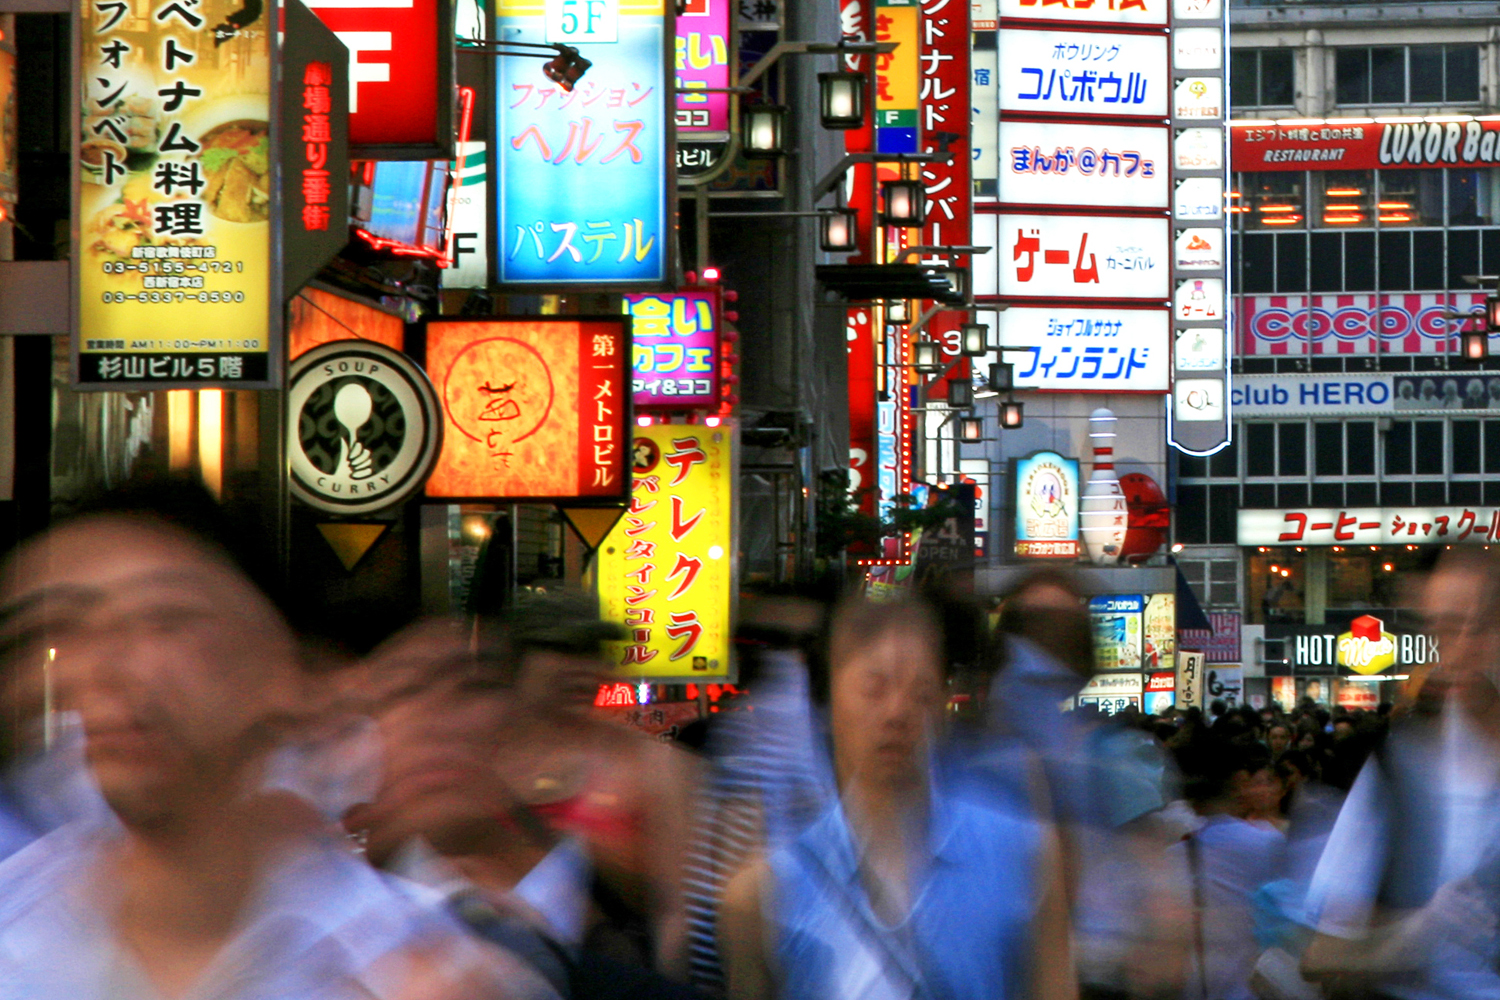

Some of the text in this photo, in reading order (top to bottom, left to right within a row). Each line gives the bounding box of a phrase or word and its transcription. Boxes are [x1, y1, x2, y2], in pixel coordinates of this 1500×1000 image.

[561, 0, 607, 35] 5F
[510, 81, 654, 111] ファッション
[1017, 66, 1147, 105] コパボウル
[511, 116, 647, 166] ヘルス
[1263, 148, 1346, 163] RESTAURANT
[1379, 121, 1461, 165] LUXOR
[1011, 146, 1155, 179] まんが@カフェ
[509, 216, 656, 265] パステル
[1013, 228, 1100, 285] ゲーム
[102, 261, 244, 274] 03-5155-4721
[323, 361, 382, 376] SOUP
[1018, 345, 1150, 380] フィンランド
[1300, 381, 1390, 406] HERO
[591, 334, 616, 488] 第一メトロビル
[316, 472, 391, 494] CURRY
[1278, 512, 1381, 542] コーヒー
[664, 436, 708, 663] テレクラ
[1296, 635, 1335, 666] HOT
[1401, 634, 1440, 665] BOX
